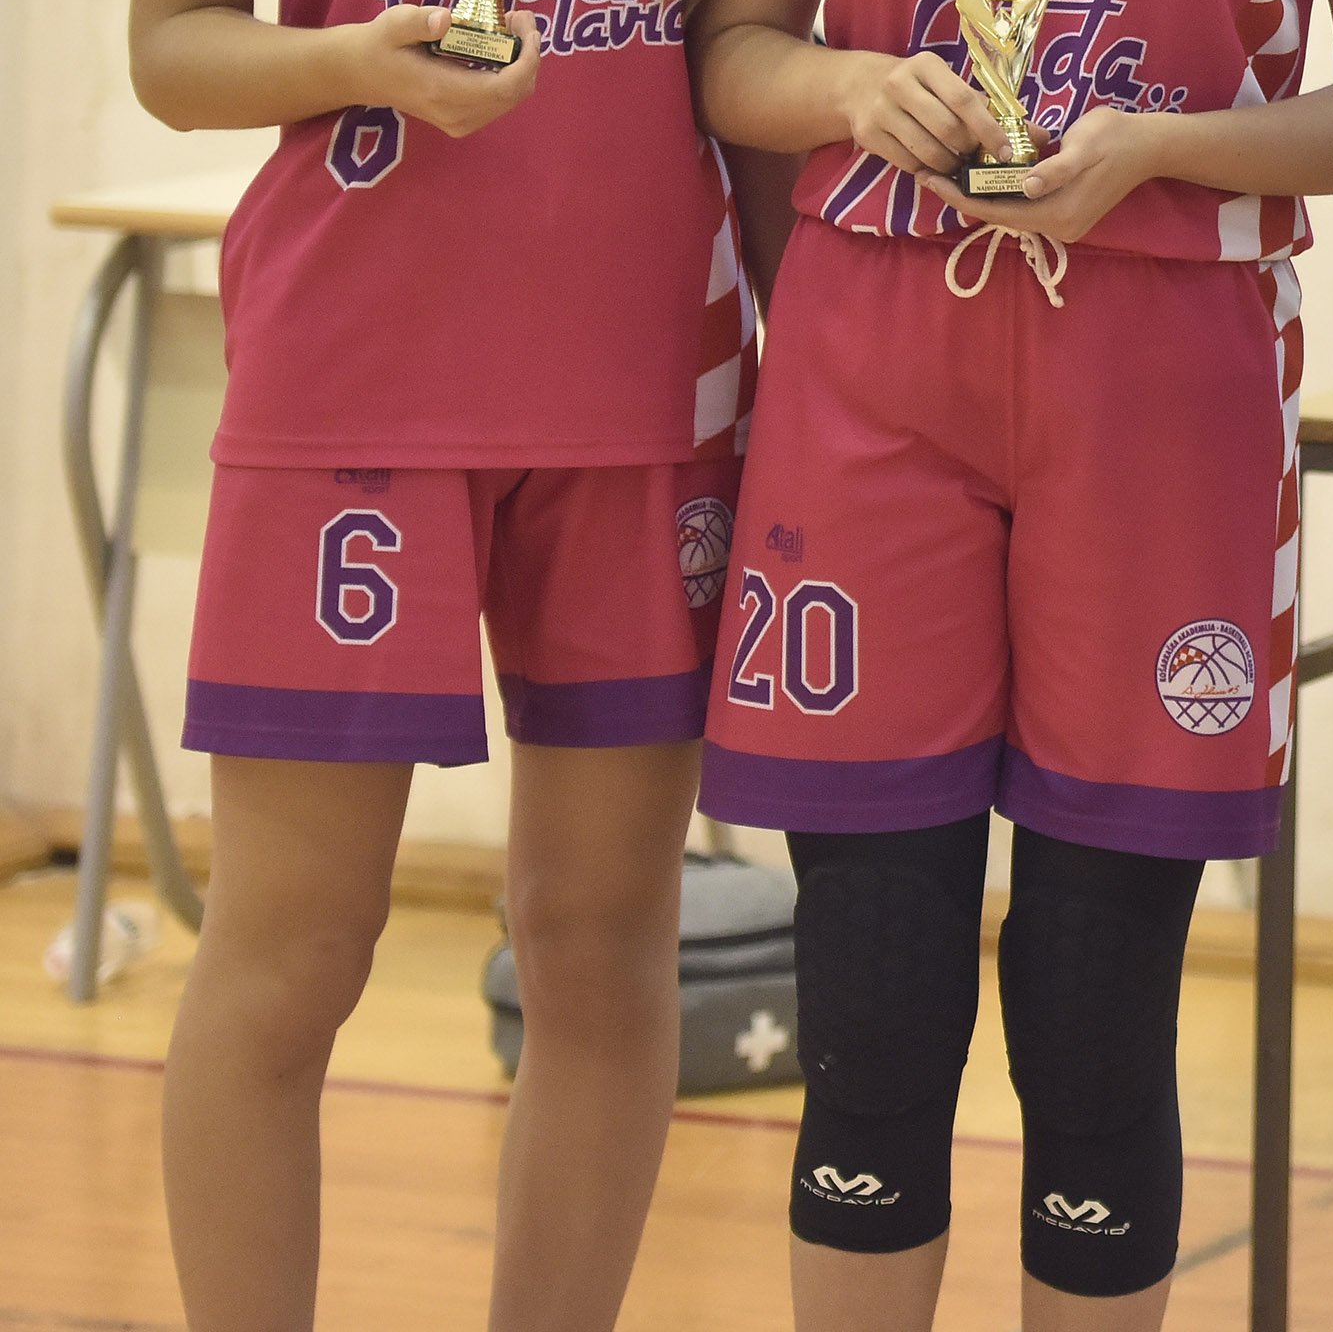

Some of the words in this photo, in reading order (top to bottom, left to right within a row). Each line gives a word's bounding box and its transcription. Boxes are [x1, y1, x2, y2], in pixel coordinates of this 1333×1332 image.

[475, 49, 505, 60] PETORKA
[315, 508, 401, 646] 6
[765, 523, 804, 551] Atali
[727, 566, 859, 716] 20
